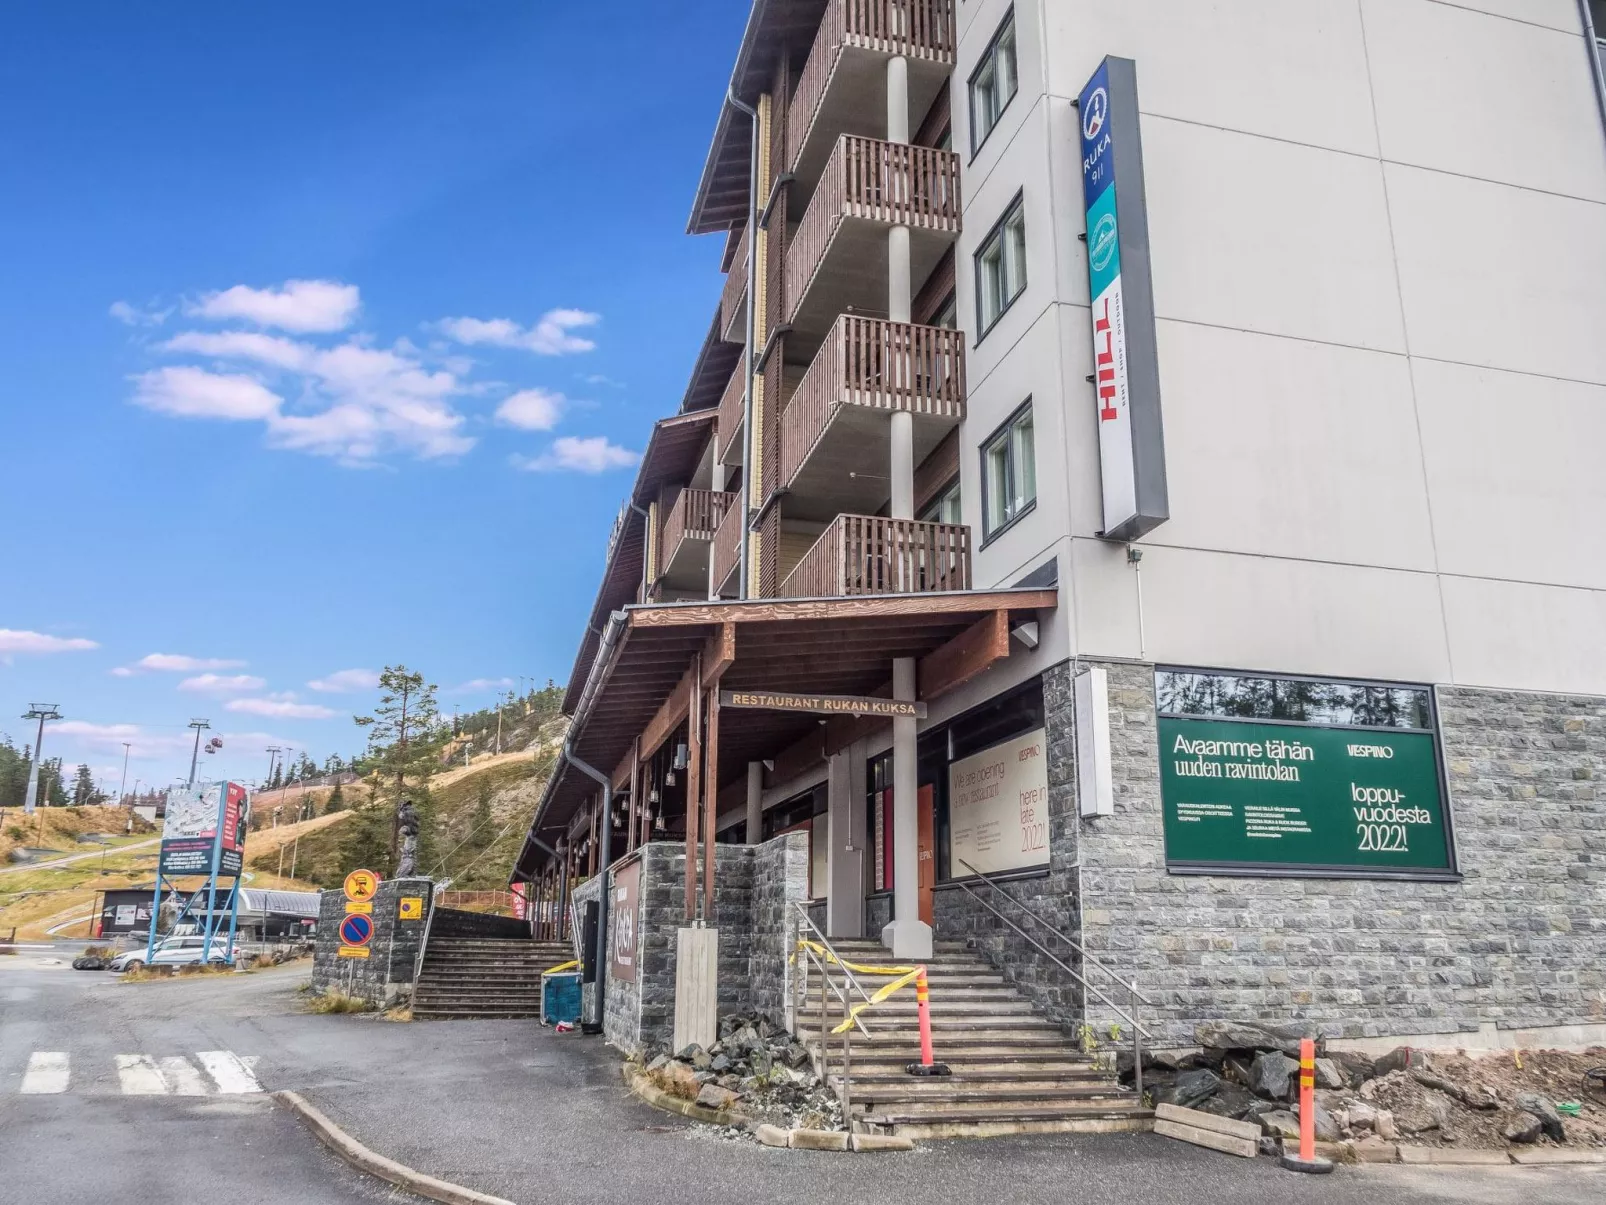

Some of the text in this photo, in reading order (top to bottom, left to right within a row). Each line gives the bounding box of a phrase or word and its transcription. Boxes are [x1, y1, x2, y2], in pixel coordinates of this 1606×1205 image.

[1084, 137, 1111, 174] RUKA
[1091, 165, 1104, 185] 911
[1114, 292, 1122, 336] OUTDOOR
[1096, 297, 1117, 423] HILL
[732, 694, 916, 714] RESTAURANT RUKAN KUKSA
[1018, 744, 1040, 761] VESPINO
[1173, 734, 1314, 761] Avaamme tähän
[1347, 744, 1393, 759] VESPINO
[954, 762, 1005, 789] We are opening
[1174, 755, 1300, 782] uuden ravintolan
[970, 783, 999, 803] restaurant
[1019, 784, 1047, 806] here in
[1351, 782, 1406, 806] loppu-
[1020, 805, 1034, 824] late
[1353, 804, 1432, 824] vuodesta
[1022, 824, 1046, 853] 2022!
[1357, 824, 1409, 851] 2022!
